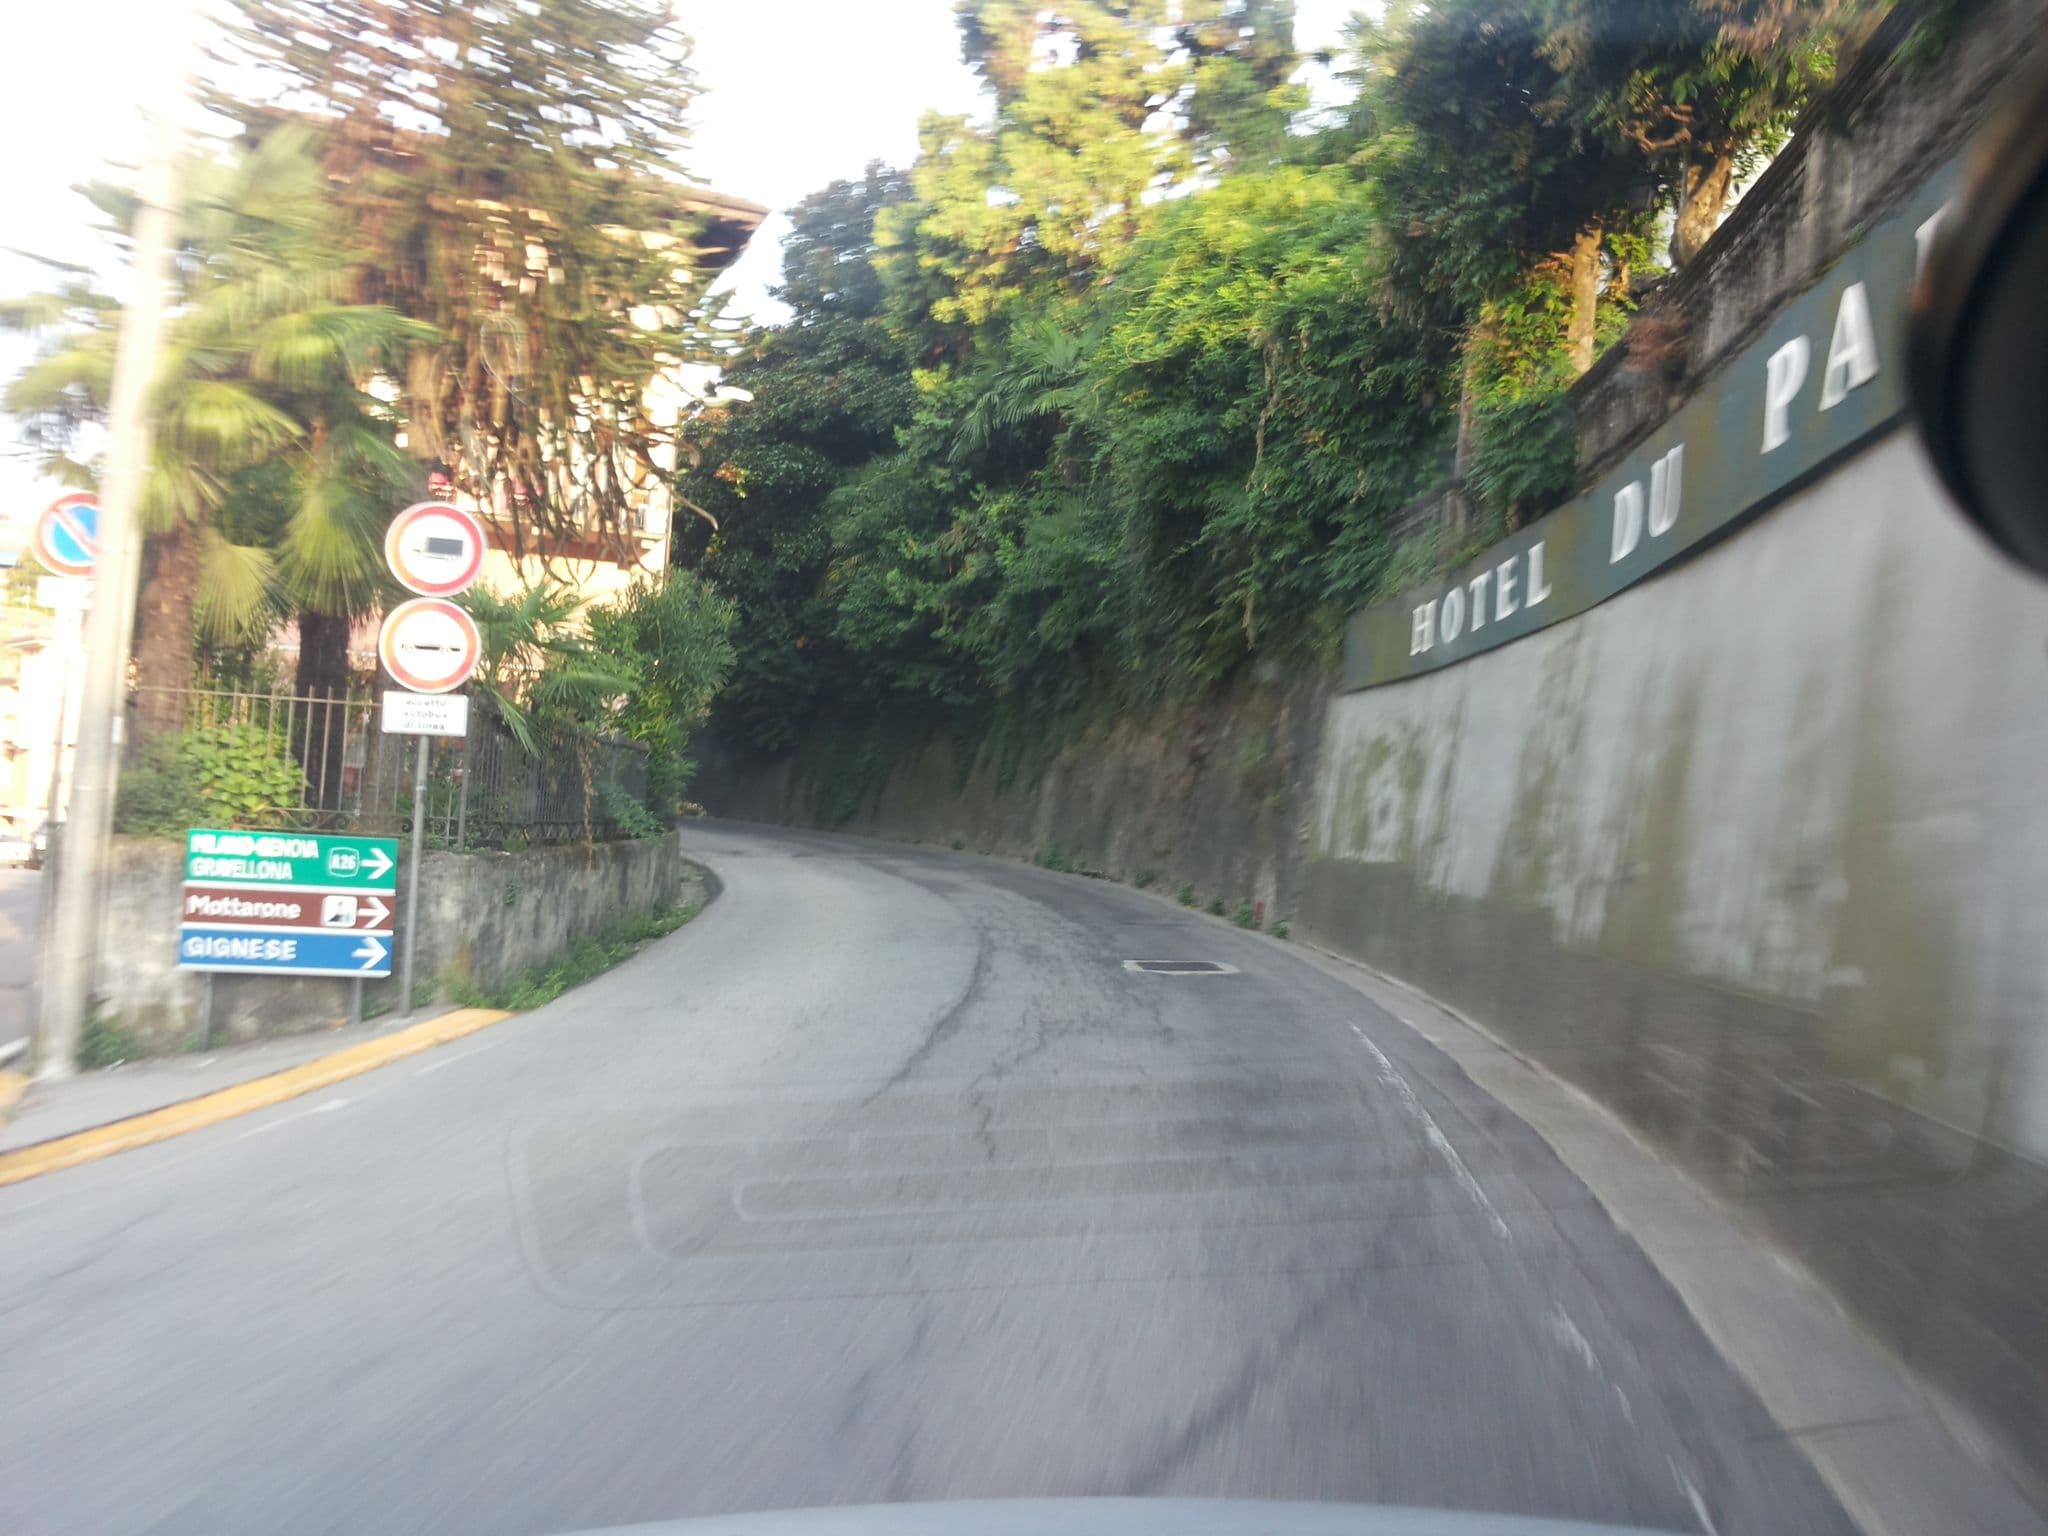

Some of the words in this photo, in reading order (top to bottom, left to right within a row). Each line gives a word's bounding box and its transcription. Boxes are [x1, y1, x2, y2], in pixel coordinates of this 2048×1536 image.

[1410, 541, 1552, 656] HOTEL
[1610, 443, 1685, 565] DU
[186, 895, 301, 919] Mottarone
[184, 936, 298, 961] GIGNESE
